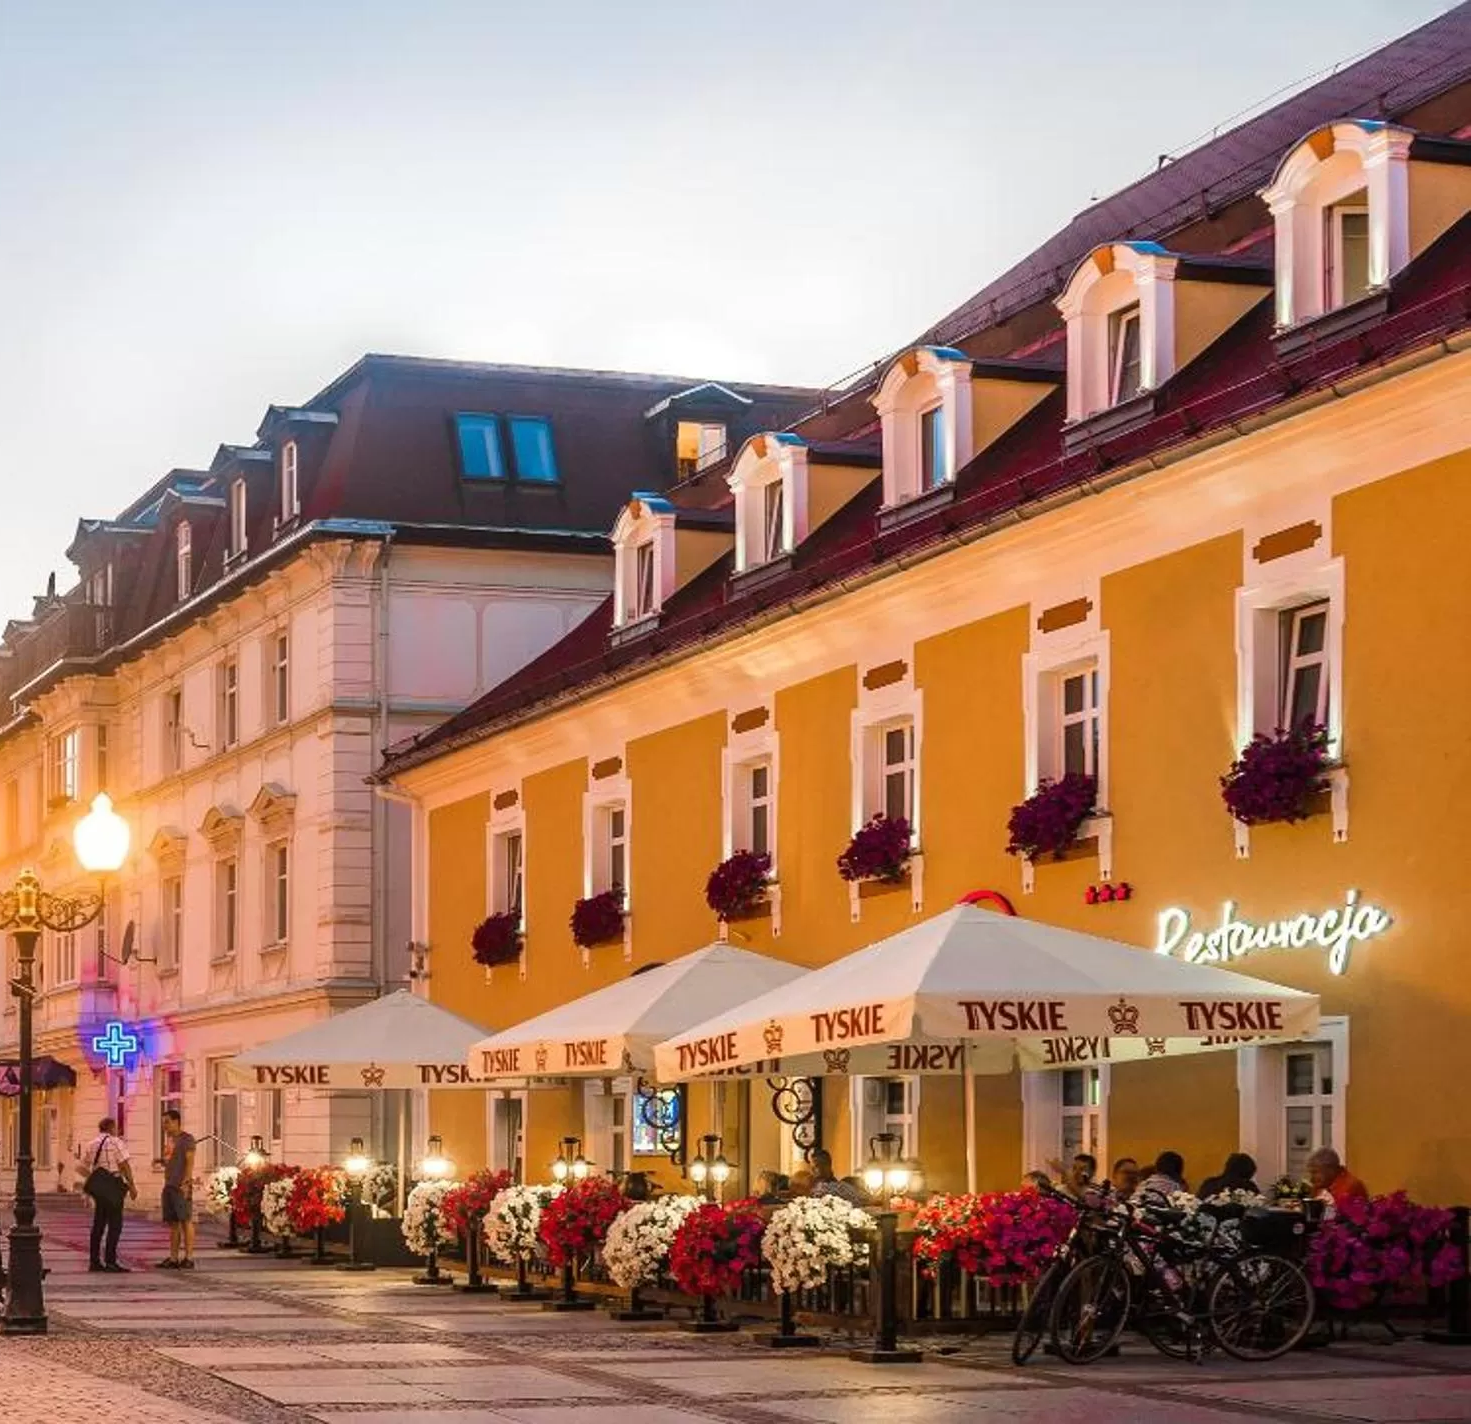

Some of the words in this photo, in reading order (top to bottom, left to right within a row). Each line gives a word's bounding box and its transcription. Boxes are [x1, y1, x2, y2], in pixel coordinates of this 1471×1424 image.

[1155, 888, 1394, 976] Restauracja
[958, 1001, 1068, 1031] TYSKIE
[1179, 1001, 1284, 1031] TYSKIE
[676, 1032, 738, 1070] TYSKIE
[811, 1004, 885, 1043] TYSKIE
[252, 1064, 330, 1084] TYSKIE
[415, 1064, 496, 1084] TYSK
[482, 1048, 521, 1074] TYSKIE
[563, 1039, 608, 1067] TYSKIE
